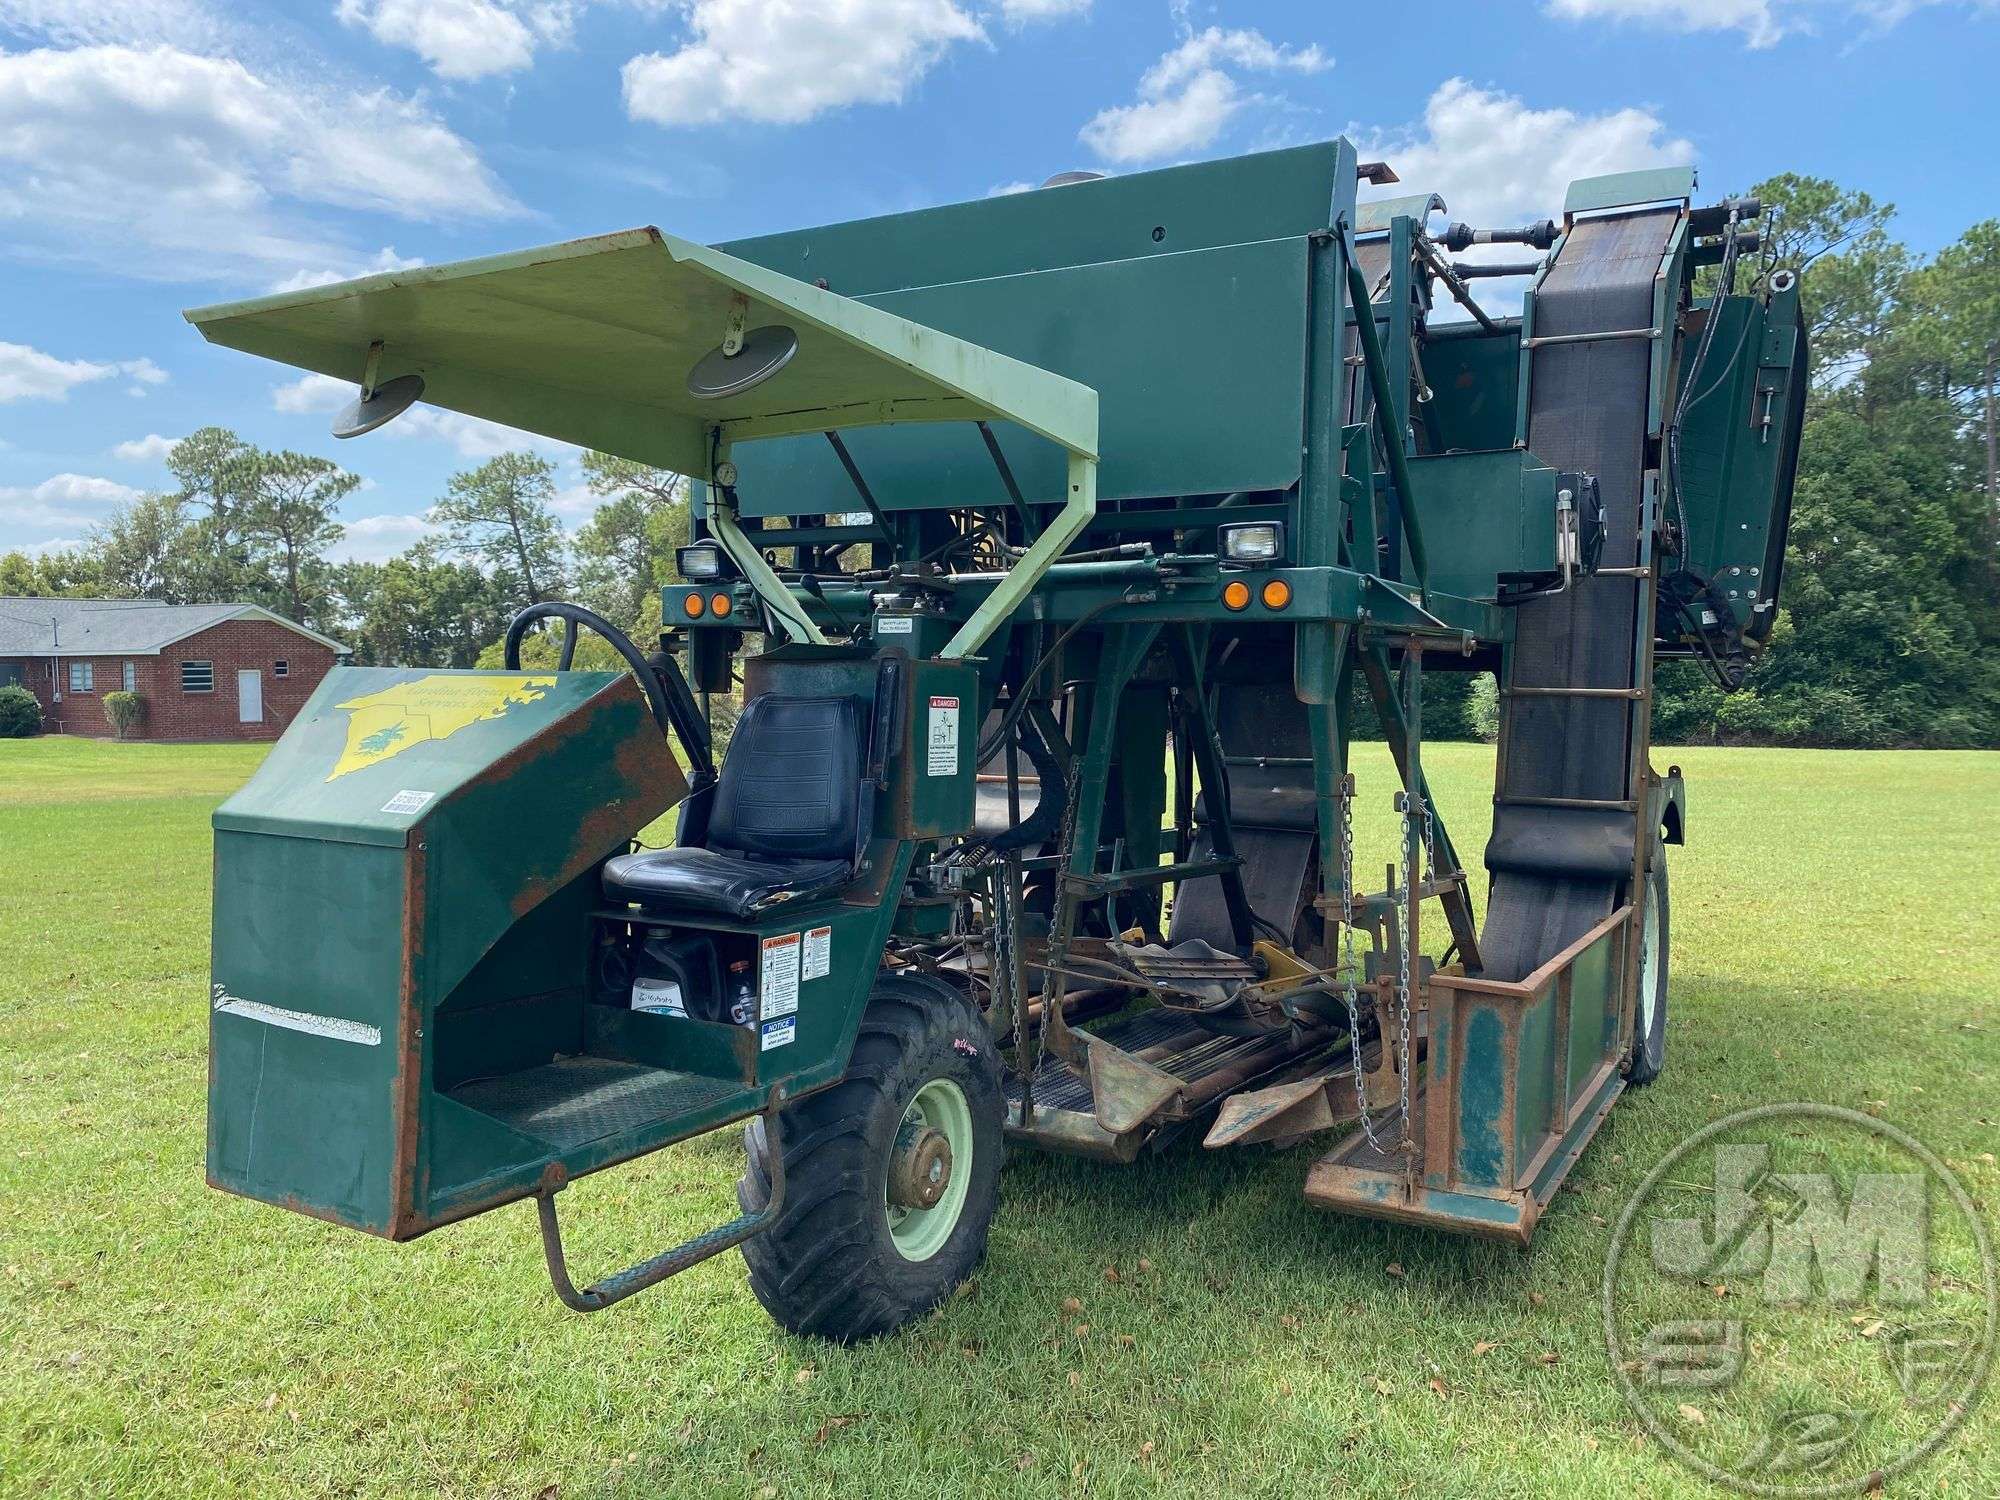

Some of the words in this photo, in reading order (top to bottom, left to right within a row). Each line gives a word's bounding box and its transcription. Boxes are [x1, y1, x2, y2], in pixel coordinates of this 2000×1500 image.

[937, 700, 956, 708] DANGER
[648, 993, 673, 1004] Kubota
[731, 1004, 747, 1023] G
[768, 1020, 789, 1032] NOTICE
